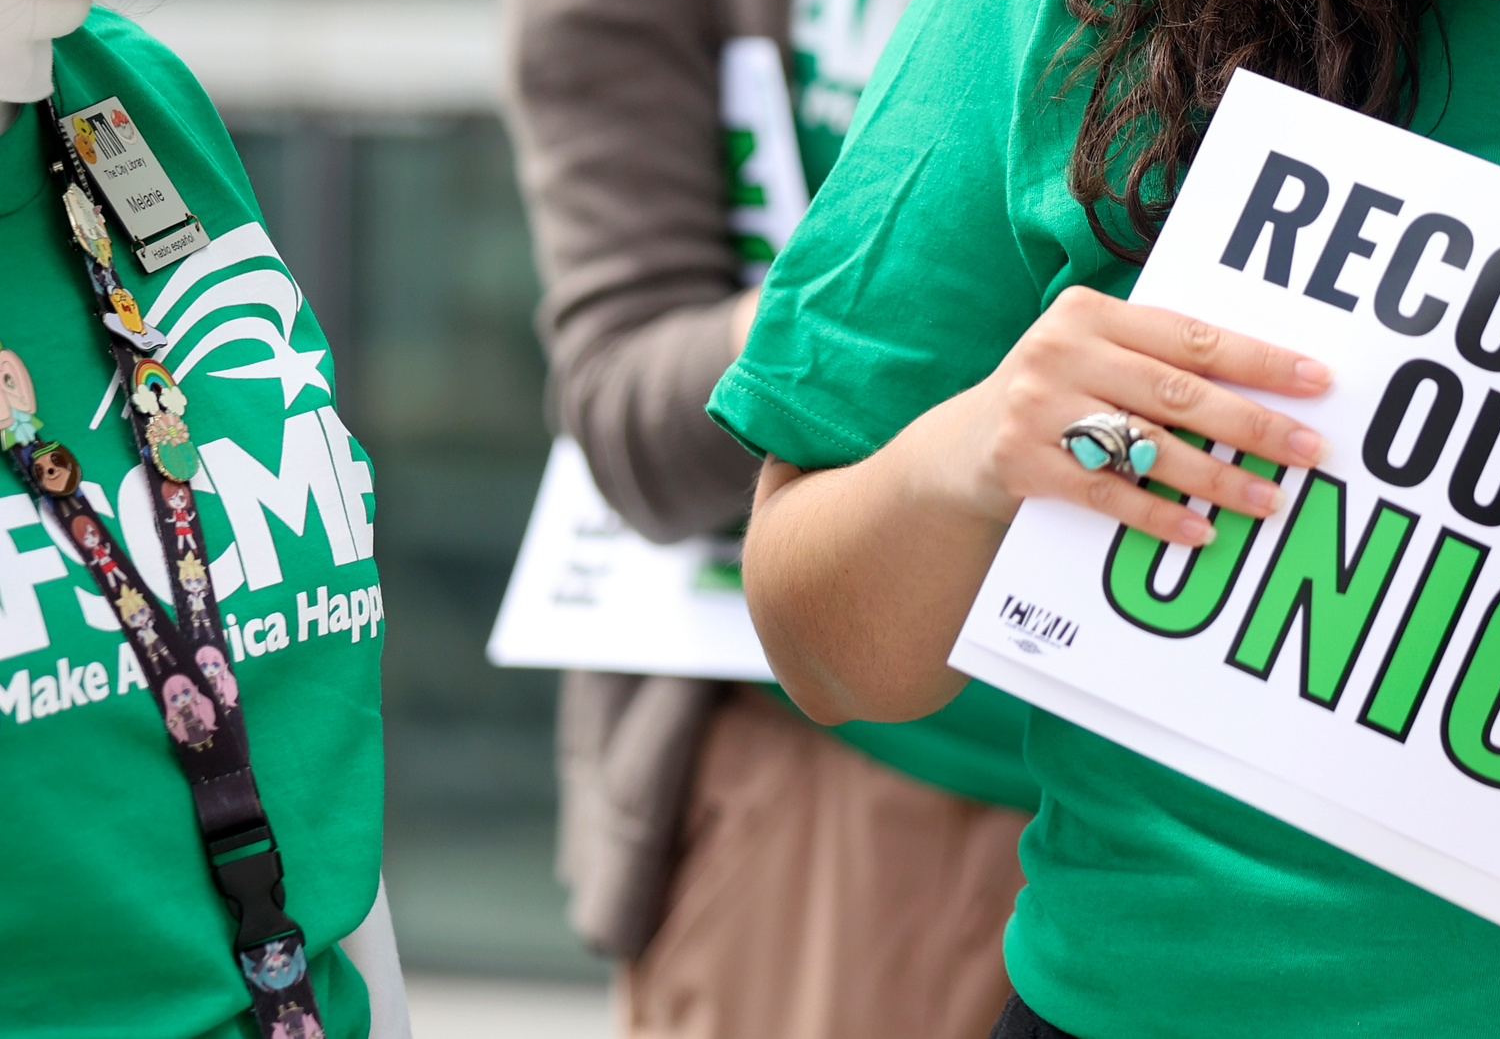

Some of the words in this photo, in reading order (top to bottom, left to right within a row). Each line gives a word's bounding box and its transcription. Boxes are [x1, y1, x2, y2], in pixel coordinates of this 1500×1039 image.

[104, 169, 118, 180] The
[115, 163, 129, 175] City
[127, 157, 147, 172] Library
[126, 188, 165, 214] Melanie
[151, 244, 173, 260] Hablo
[171, 232, 195, 252] español
[296, 585, 385, 643] Happ
